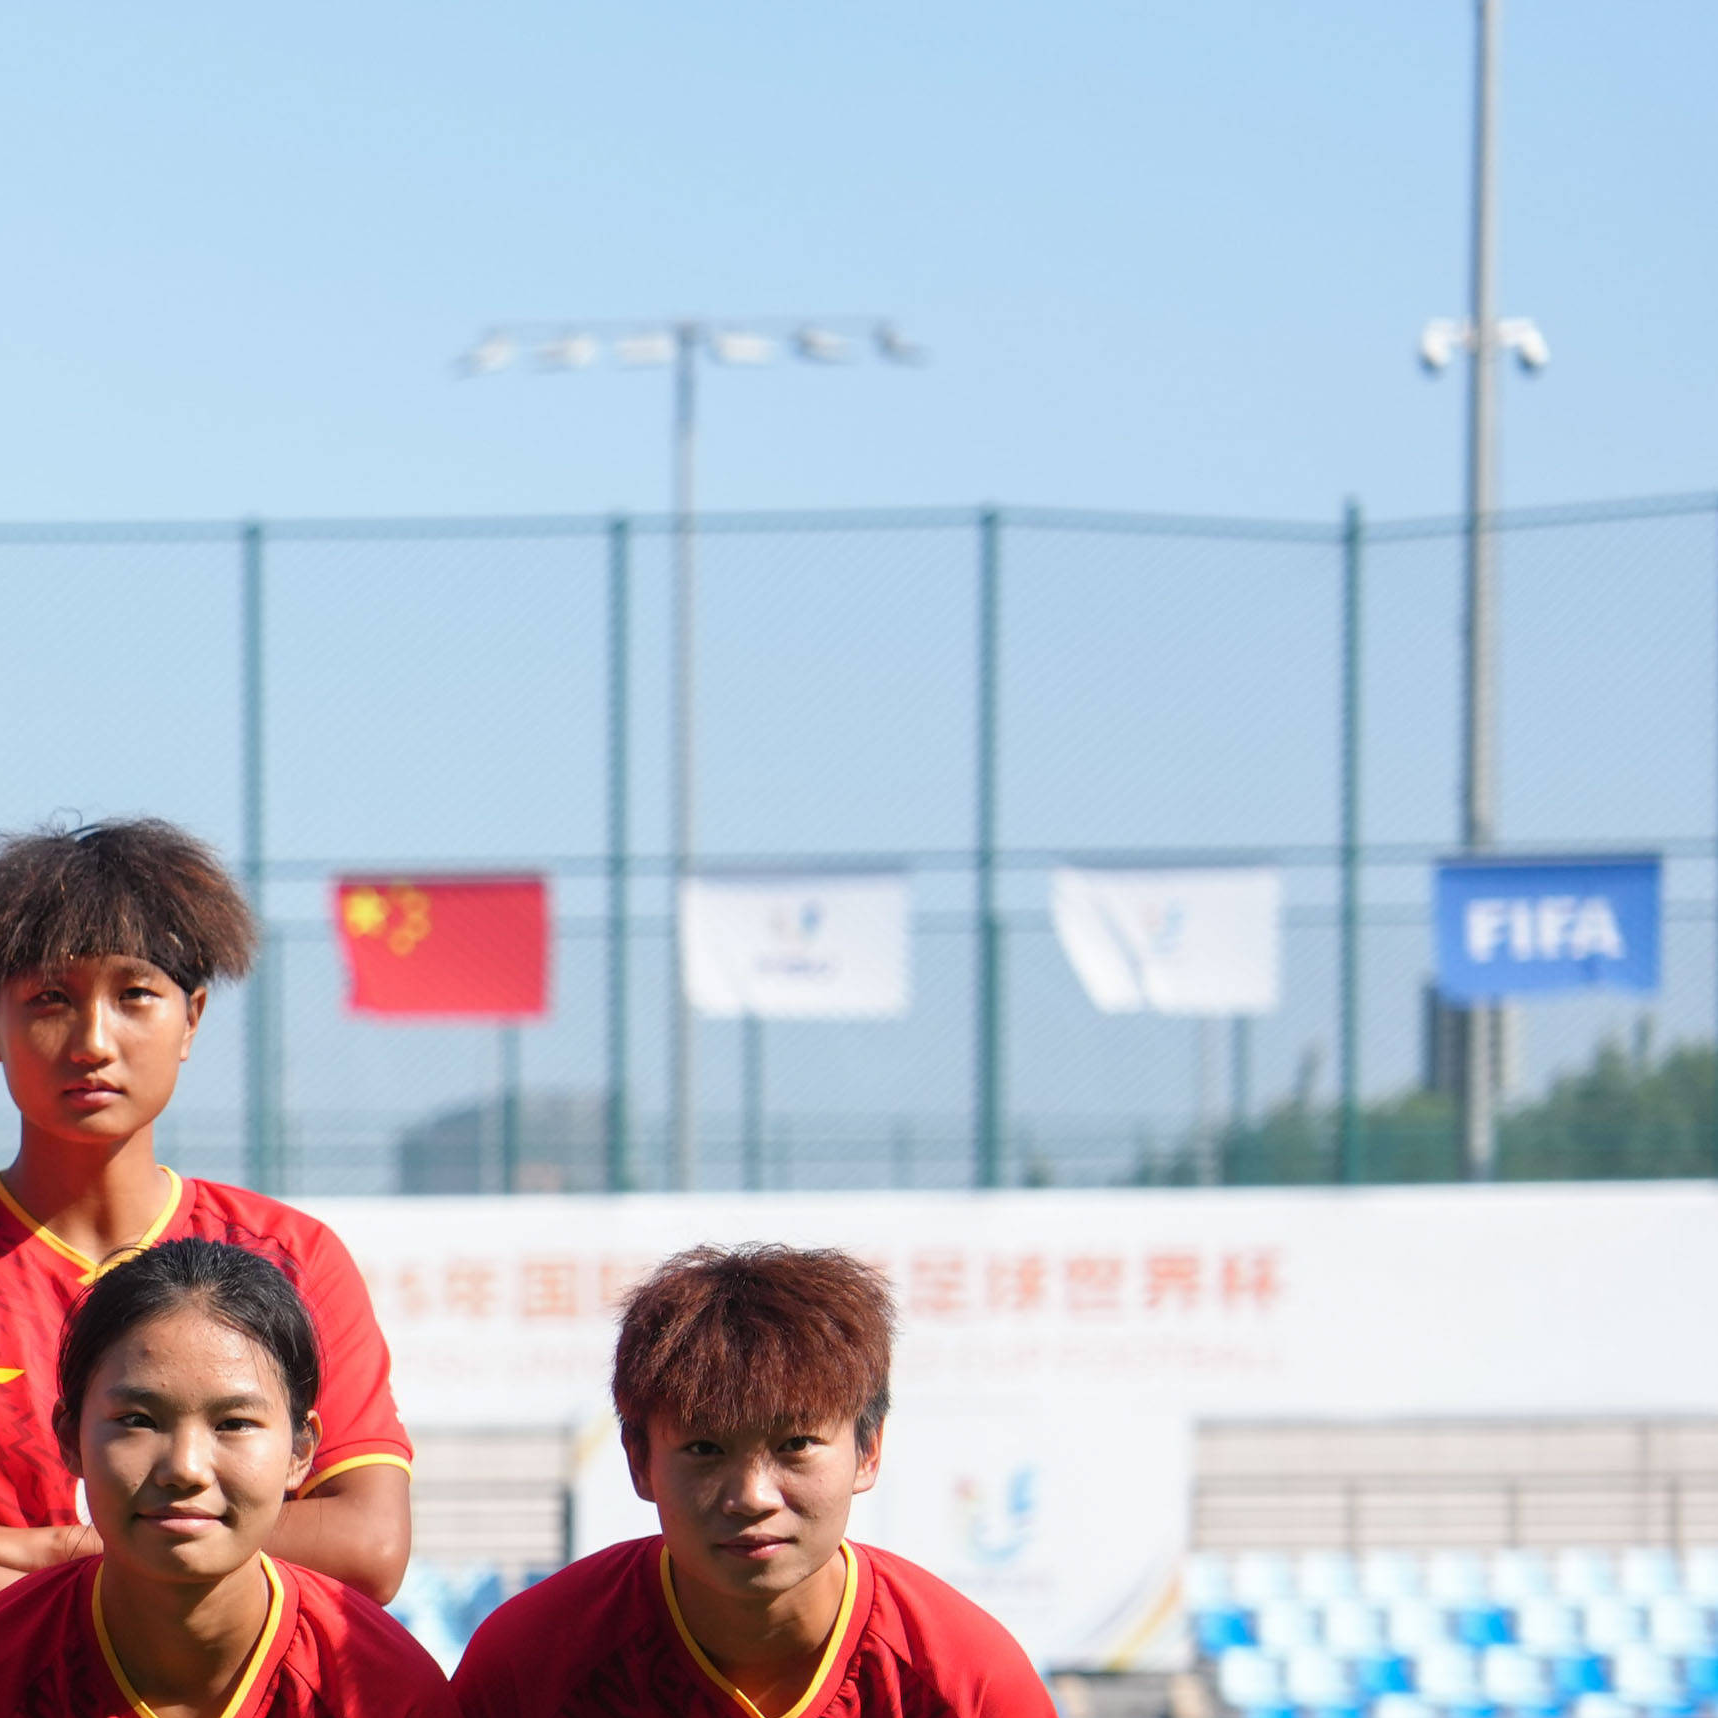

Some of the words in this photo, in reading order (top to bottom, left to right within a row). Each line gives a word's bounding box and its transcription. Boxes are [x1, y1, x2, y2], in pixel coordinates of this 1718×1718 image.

[1467, 895, 1625, 963] FIFA
[871, 1248, 1281, 1316] 足球世界杯
